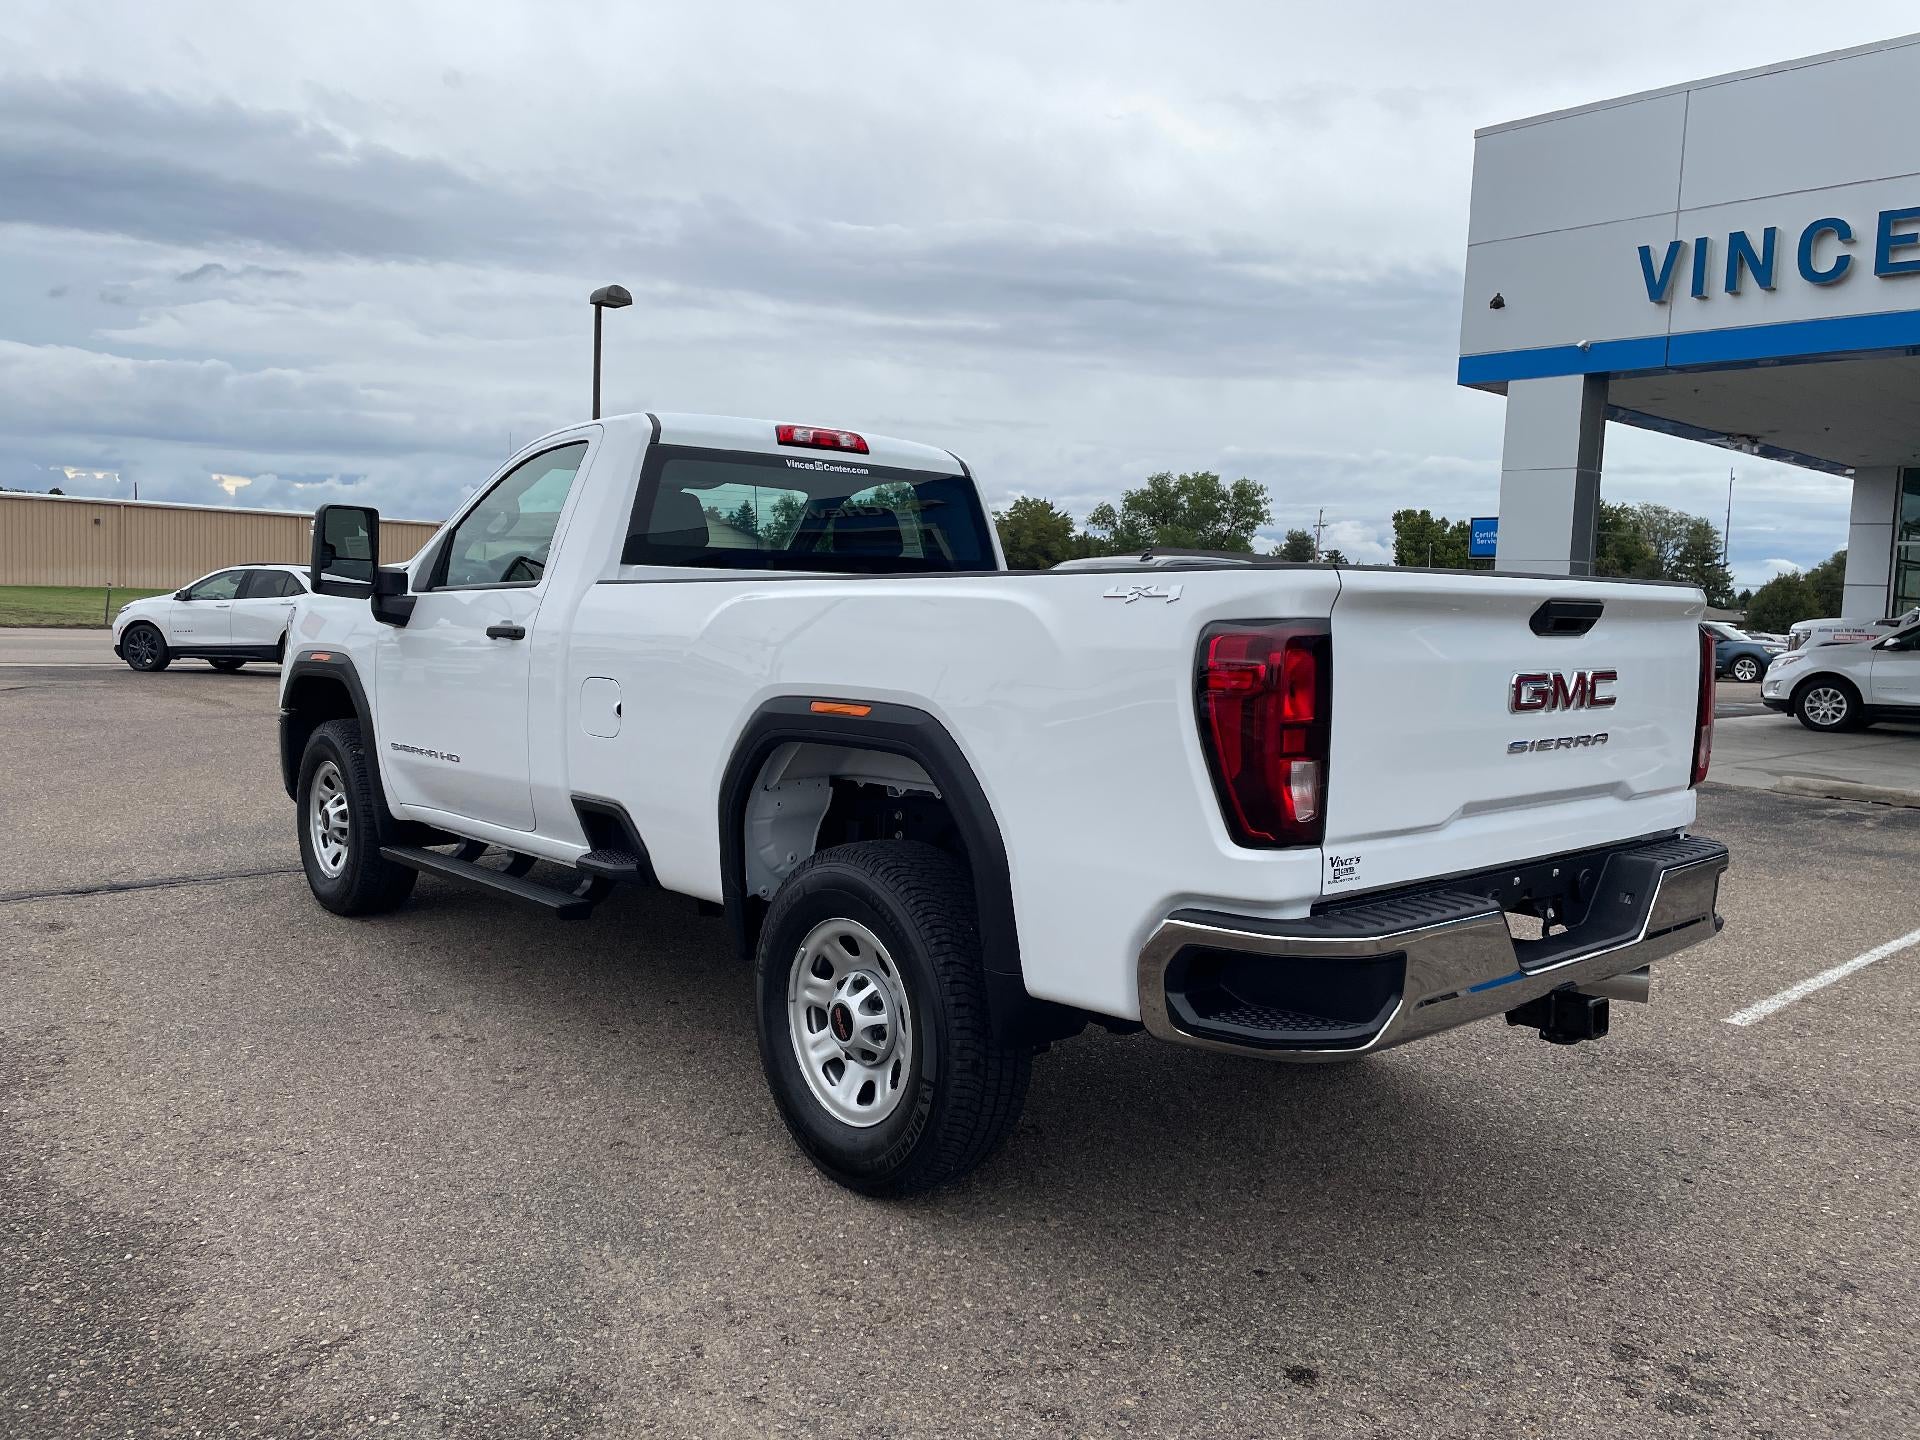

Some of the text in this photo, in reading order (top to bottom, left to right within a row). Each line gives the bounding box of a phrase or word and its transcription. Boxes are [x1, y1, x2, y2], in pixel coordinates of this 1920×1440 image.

[1508, 669, 1618, 714] GMC
[391, 742, 461, 763] SIERRA HD
[1507, 733, 1609, 754] SIERRA
